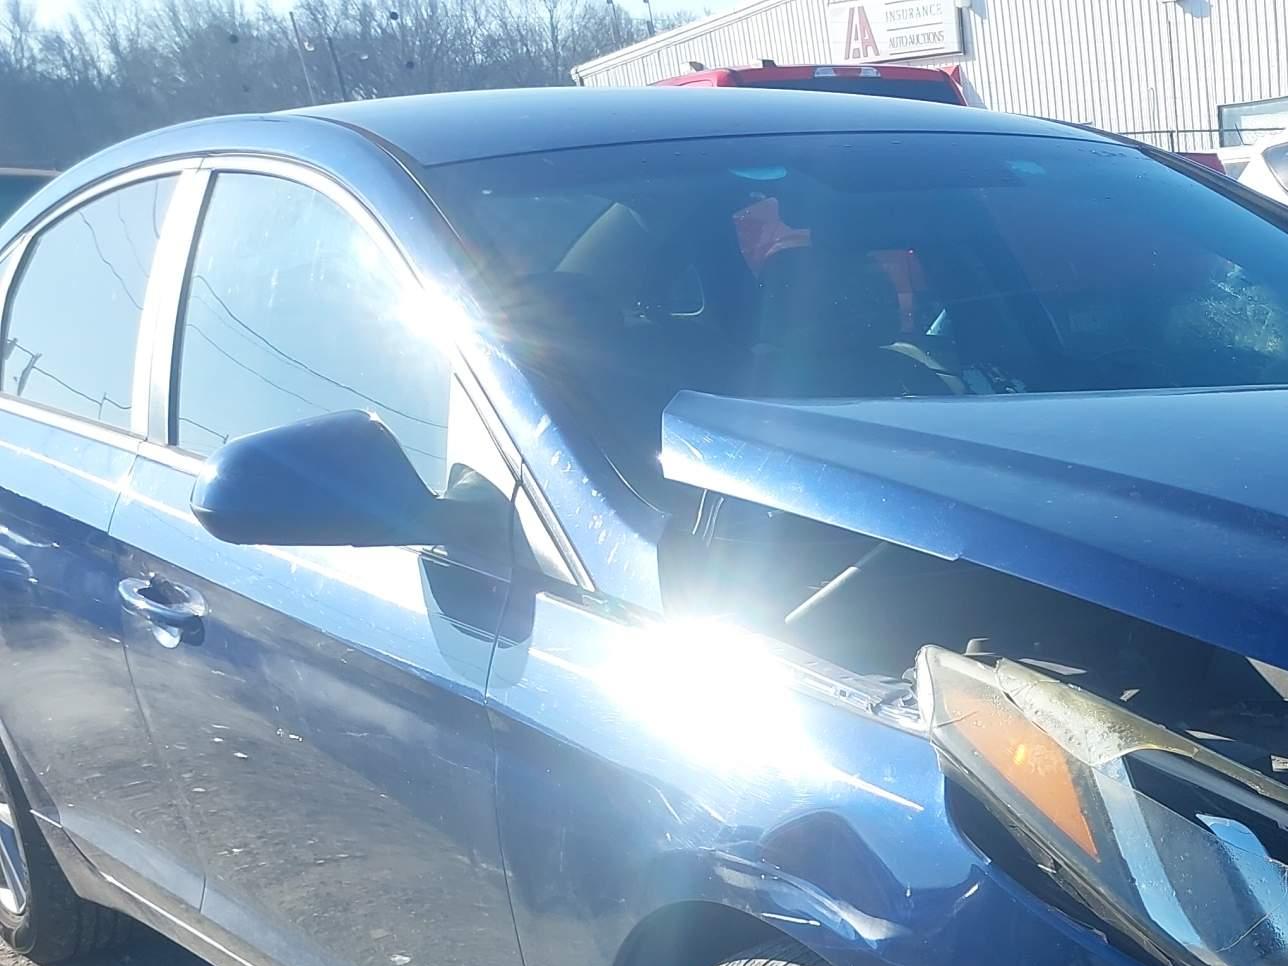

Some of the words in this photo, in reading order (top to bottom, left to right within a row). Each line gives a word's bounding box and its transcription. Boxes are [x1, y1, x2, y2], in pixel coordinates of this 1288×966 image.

[885, 3, 944, 22] INSURANCE
[888, 34, 908, 49] AUTO
[908, 30, 945, 47] AUCTIONS
